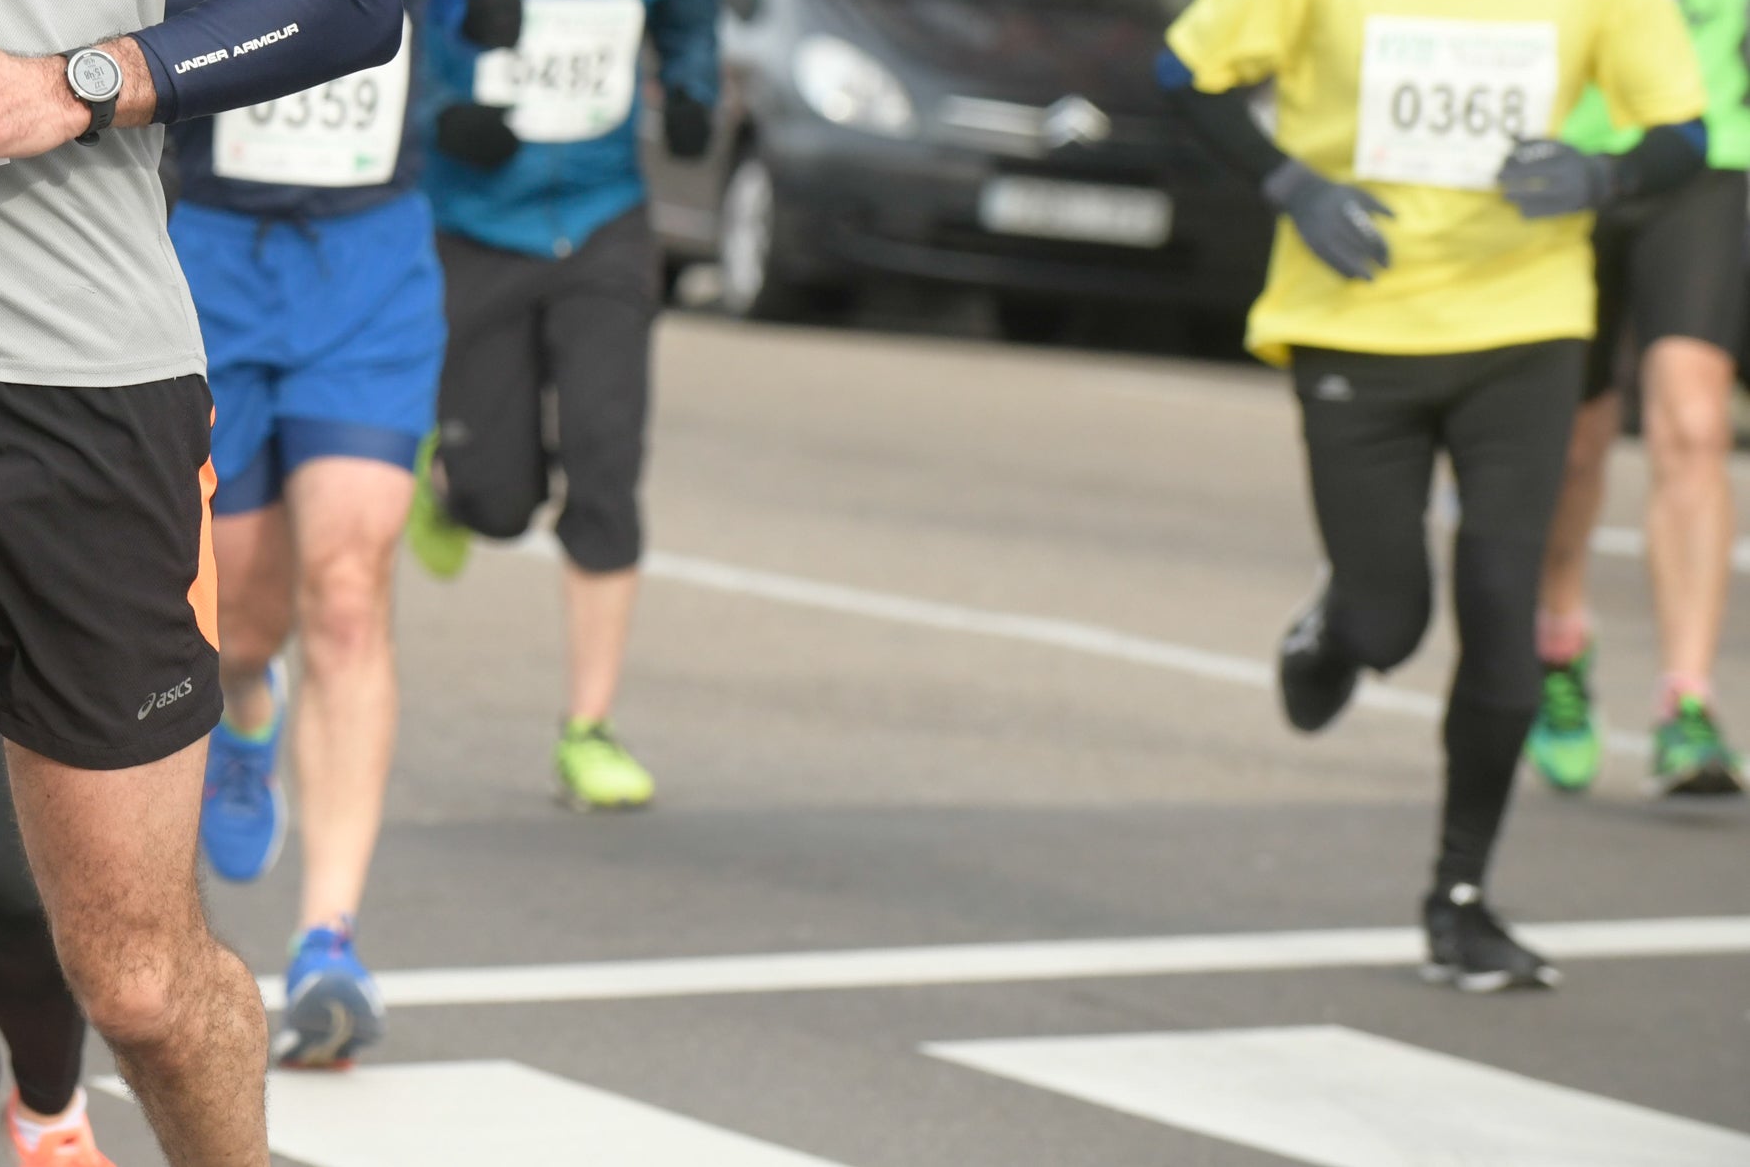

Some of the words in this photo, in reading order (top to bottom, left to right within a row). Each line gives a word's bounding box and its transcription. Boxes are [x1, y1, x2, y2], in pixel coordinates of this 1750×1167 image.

[174, 48, 229, 75] UNDER
[233, 22, 299, 58] ARMOUR
[1390, 82, 1527, 138] 0368
[156, 677, 193, 709] asics
